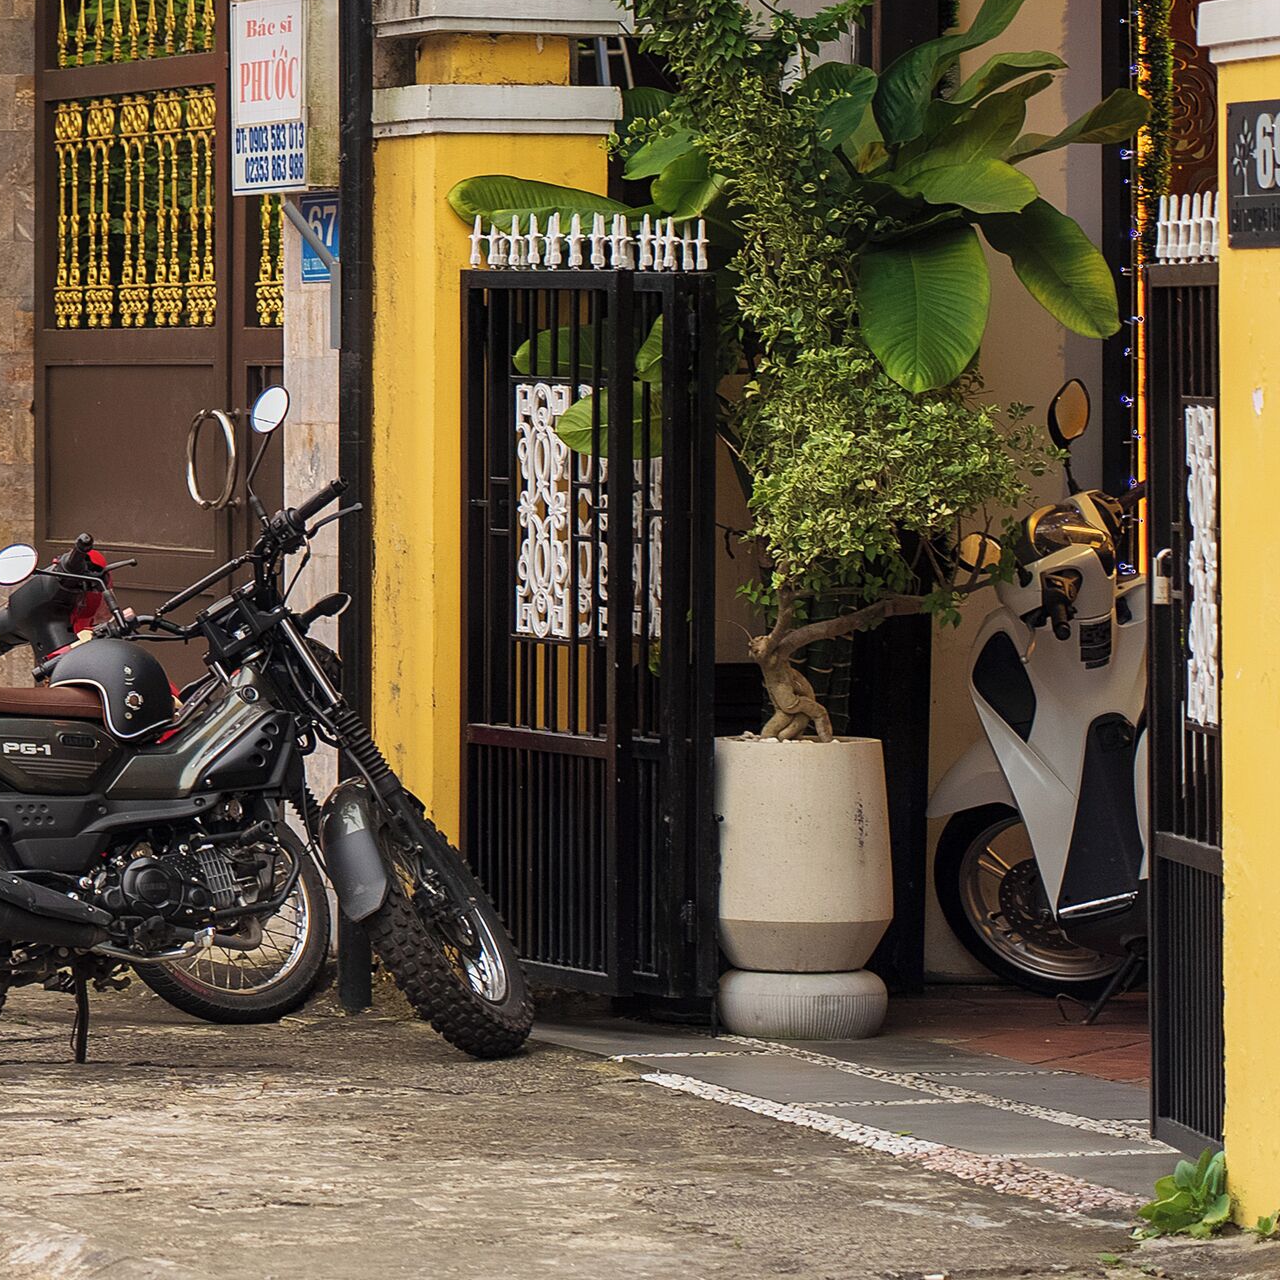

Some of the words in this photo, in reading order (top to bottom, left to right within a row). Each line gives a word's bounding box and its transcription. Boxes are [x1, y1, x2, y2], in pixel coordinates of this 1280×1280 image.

[246, 17, 275, 39] Bác
[279, 15, 293, 34] sĩ
[240, 45, 298, 104] PHƯỚC
[249, 125, 269, 154] 0903
[289, 122, 304, 150] 013
[309, 205, 337, 247] 67
[2, 742, 52, 756] PG-1
